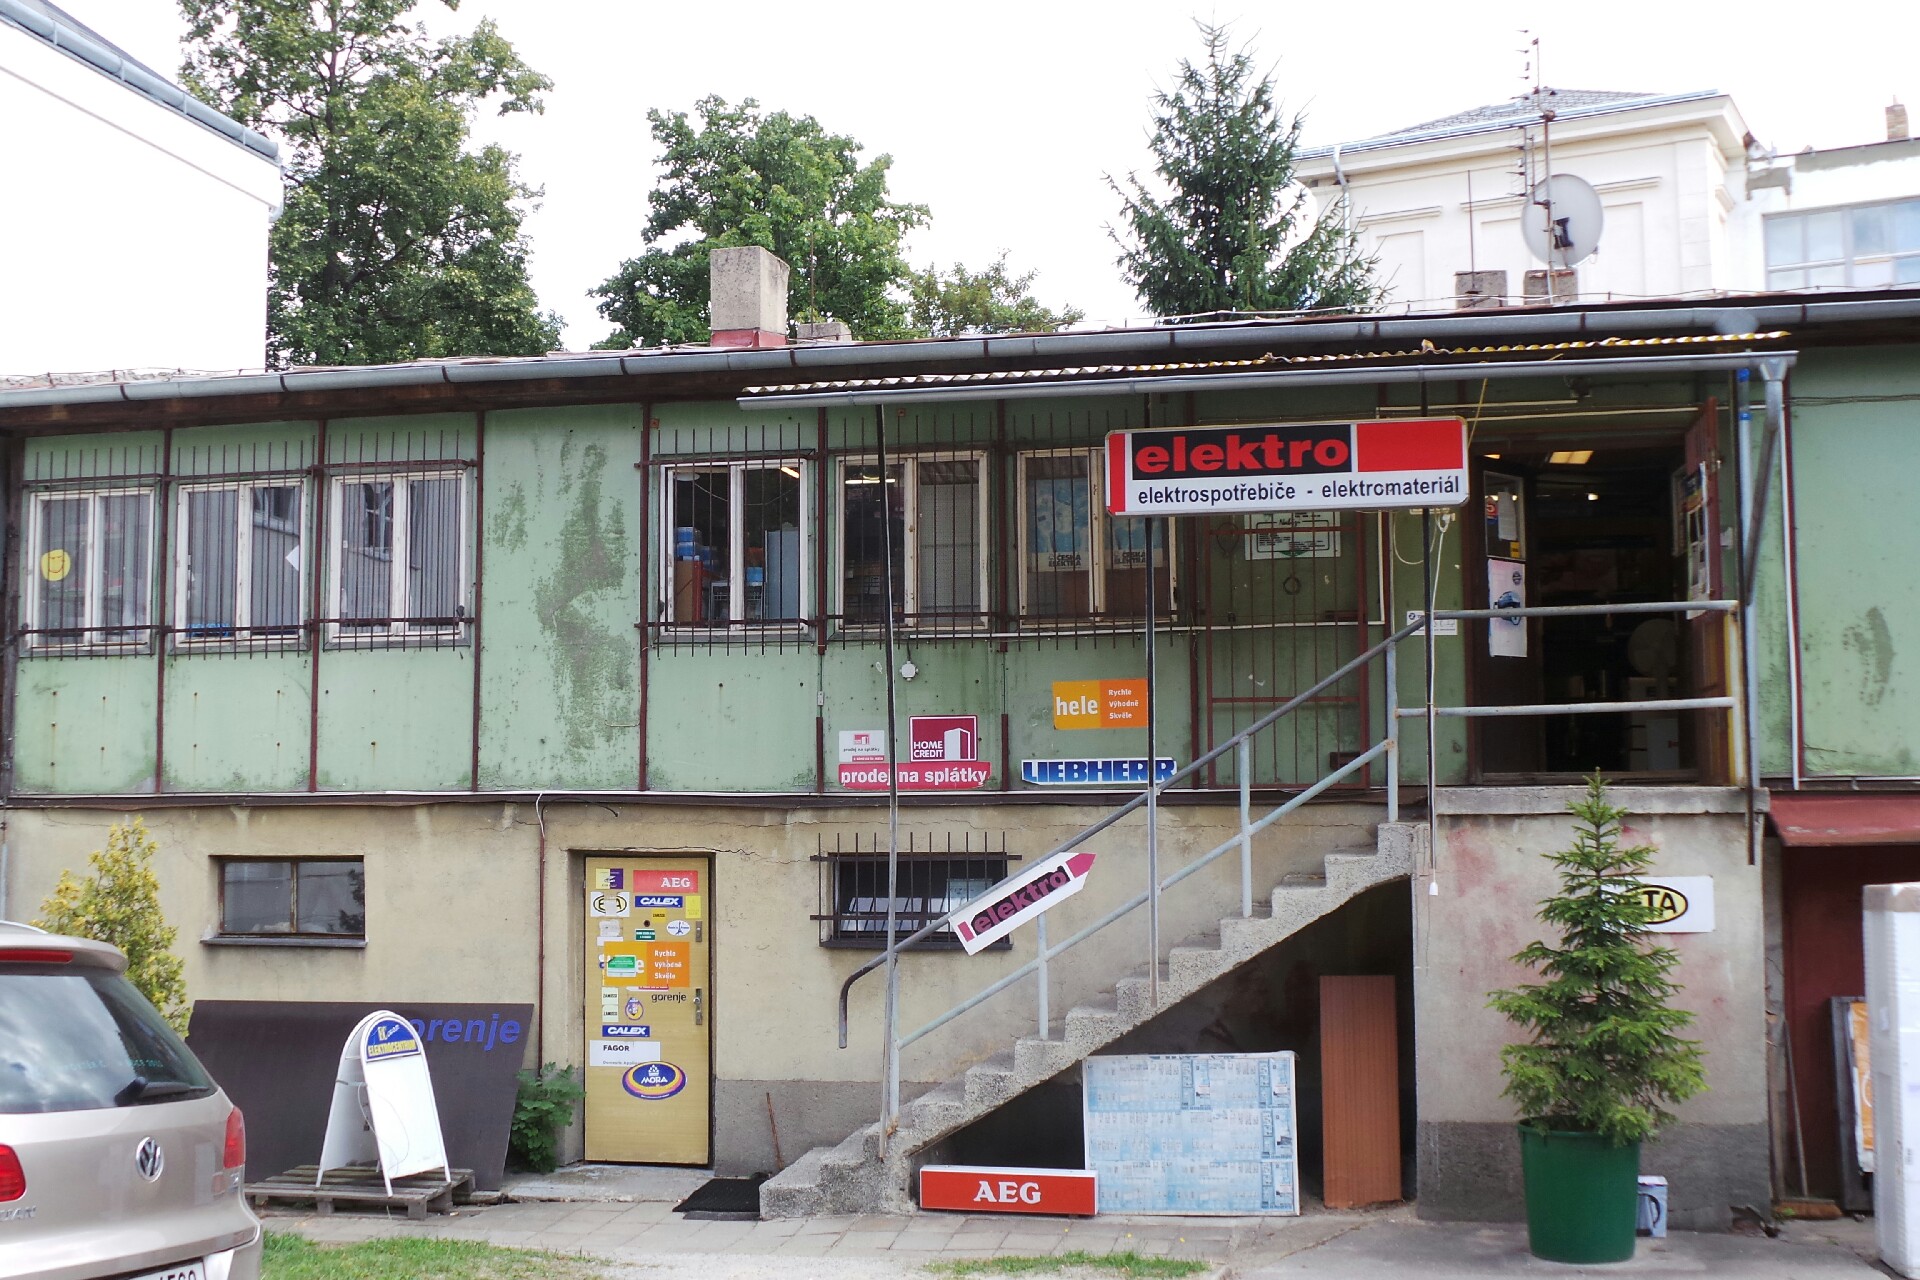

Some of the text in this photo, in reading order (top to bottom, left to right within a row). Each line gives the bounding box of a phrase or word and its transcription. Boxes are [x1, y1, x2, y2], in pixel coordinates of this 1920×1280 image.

[1135, 433, 1349, 473] elektro
[1138, 481, 1296, 506] elektrospotřebiče
[1322, 475, 1460, 498] elektromateriál
[1108, 689, 1132, 697] Rychle
[1056, 695, 1098, 716] hele
[1109, 699, 1139, 708] Výhodně
[1109, 712, 1132, 720] Skvěle
[914, 740, 943, 749] HOME
[914, 749, 943, 758] CREDIT
[841, 767, 987, 786] prodej na splátky
[1022, 760, 1175, 783] LIEBHERR
[661, 877, 691, 888] AEG
[598, 898, 622, 911] EA
[640, 897, 679, 906] CALEX
[973, 871, 1067, 933] elektro
[1643, 890, 1677, 914] TA
[654, 950, 676, 958] Rychle
[651, 992, 687, 1003] gorenje
[409, 1014, 521, 1051] orenje
[607, 1027, 646, 1035] CALEX
[973, 1180, 1042, 1205] AEG
